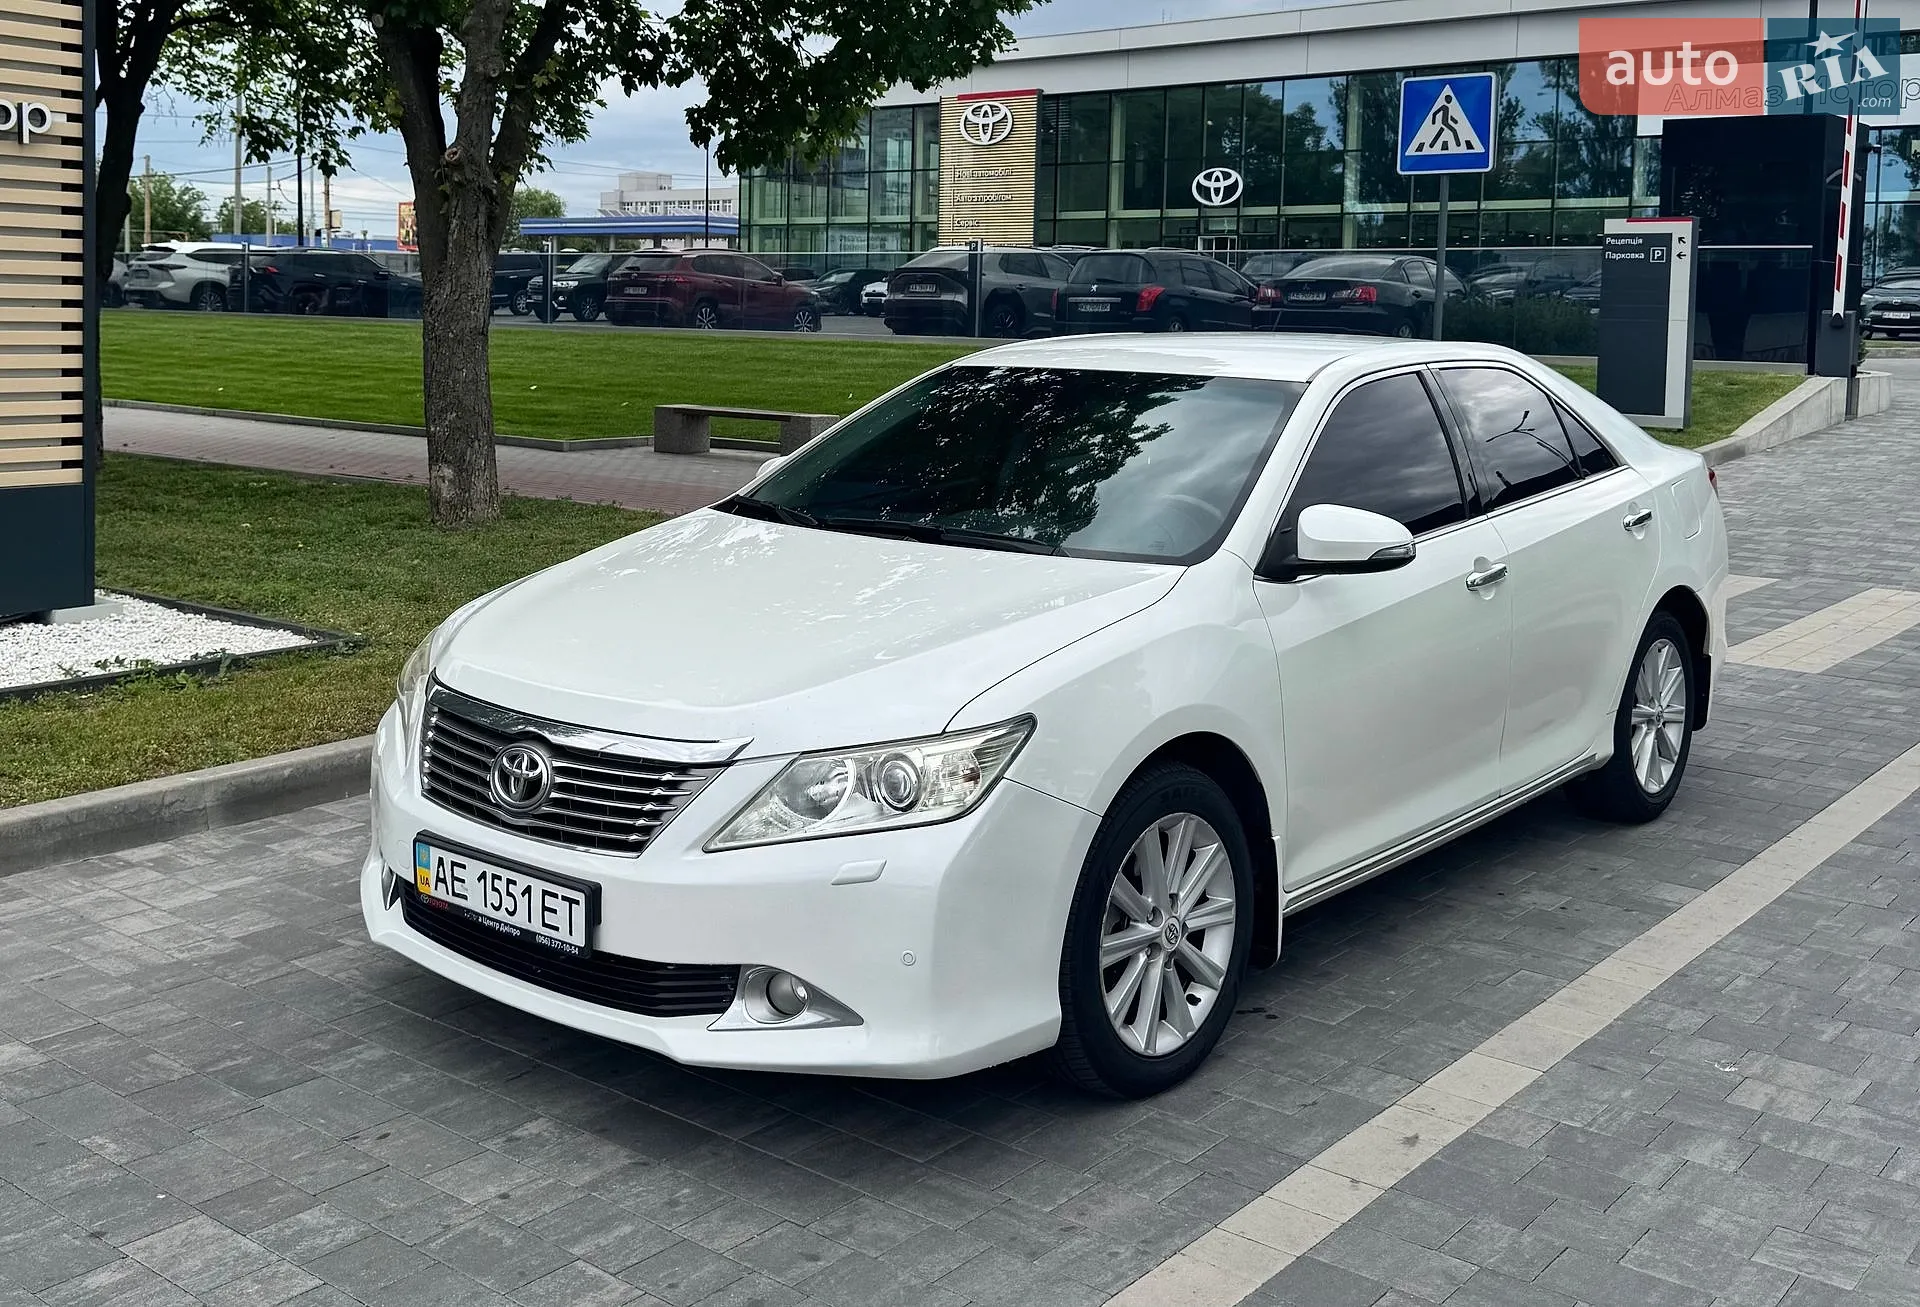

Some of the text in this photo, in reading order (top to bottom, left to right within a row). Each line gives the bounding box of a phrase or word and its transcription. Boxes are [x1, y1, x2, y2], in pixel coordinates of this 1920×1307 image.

[1664, 82, 1783, 112] Алмаз
[1605, 237, 1643, 246] Рецепція
[1605, 251, 1645, 260] Парковка
[419, 855, 581, 937] UA AE 1551 ET
[482, 915, 500, 931] Центр
